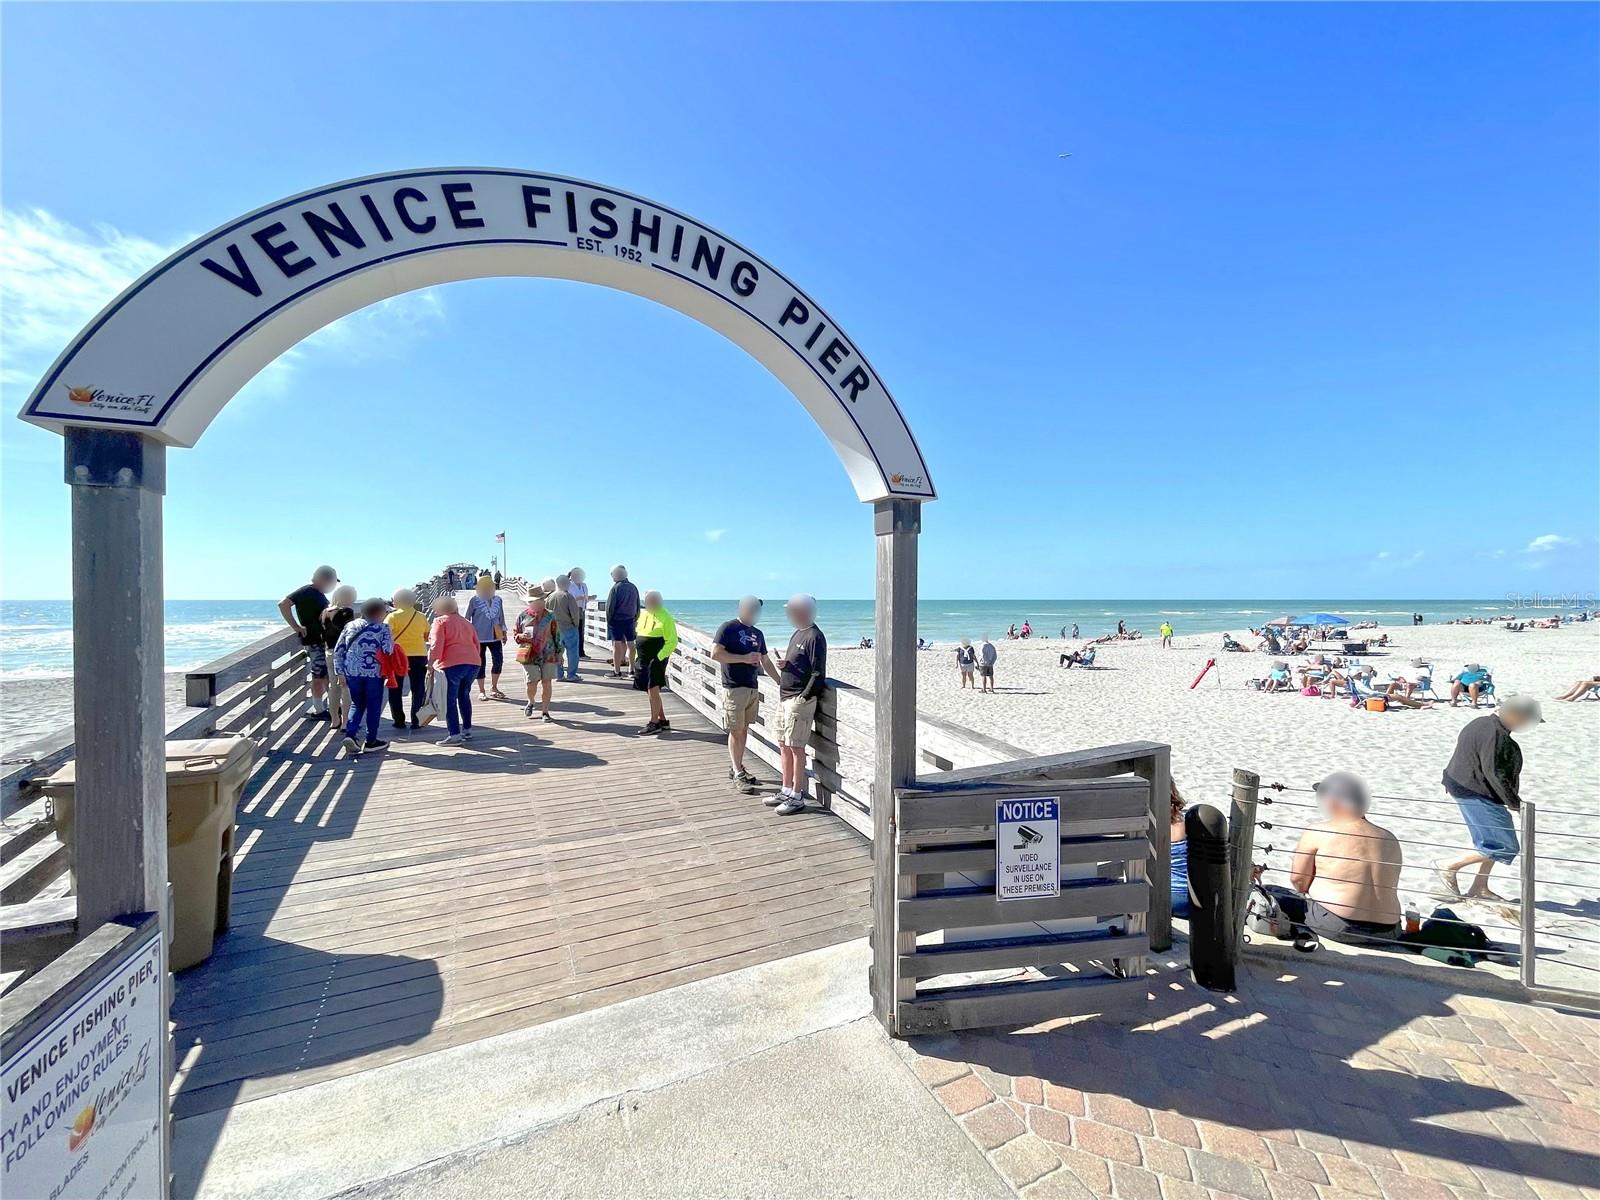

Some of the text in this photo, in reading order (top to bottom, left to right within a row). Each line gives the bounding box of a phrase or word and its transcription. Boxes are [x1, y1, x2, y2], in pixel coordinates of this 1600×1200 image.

[576, 237, 642, 263] EST. 1952
[200, 183, 870, 403] VENICE FISHING PIER
[1003, 801, 1053, 820] NOTICE
[1005, 862, 1052, 874] SURVEILLANCE
[1019, 853, 1039, 862] VIDEO
[1002, 882, 1055, 894] THESE PREMISES
[1013, 873, 1044, 883] IN USE ON
[7, 1035, 68, 1103] VENICE
[72, 985, 125, 1046] FISHING
[128, 960, 153, 994] PIER
[21, 1092, 51, 1134] AND
[55, 1014, 128, 1097] ENJOYMENT
[6, 1033, 132, 1173] FOLLOWING RULES:
